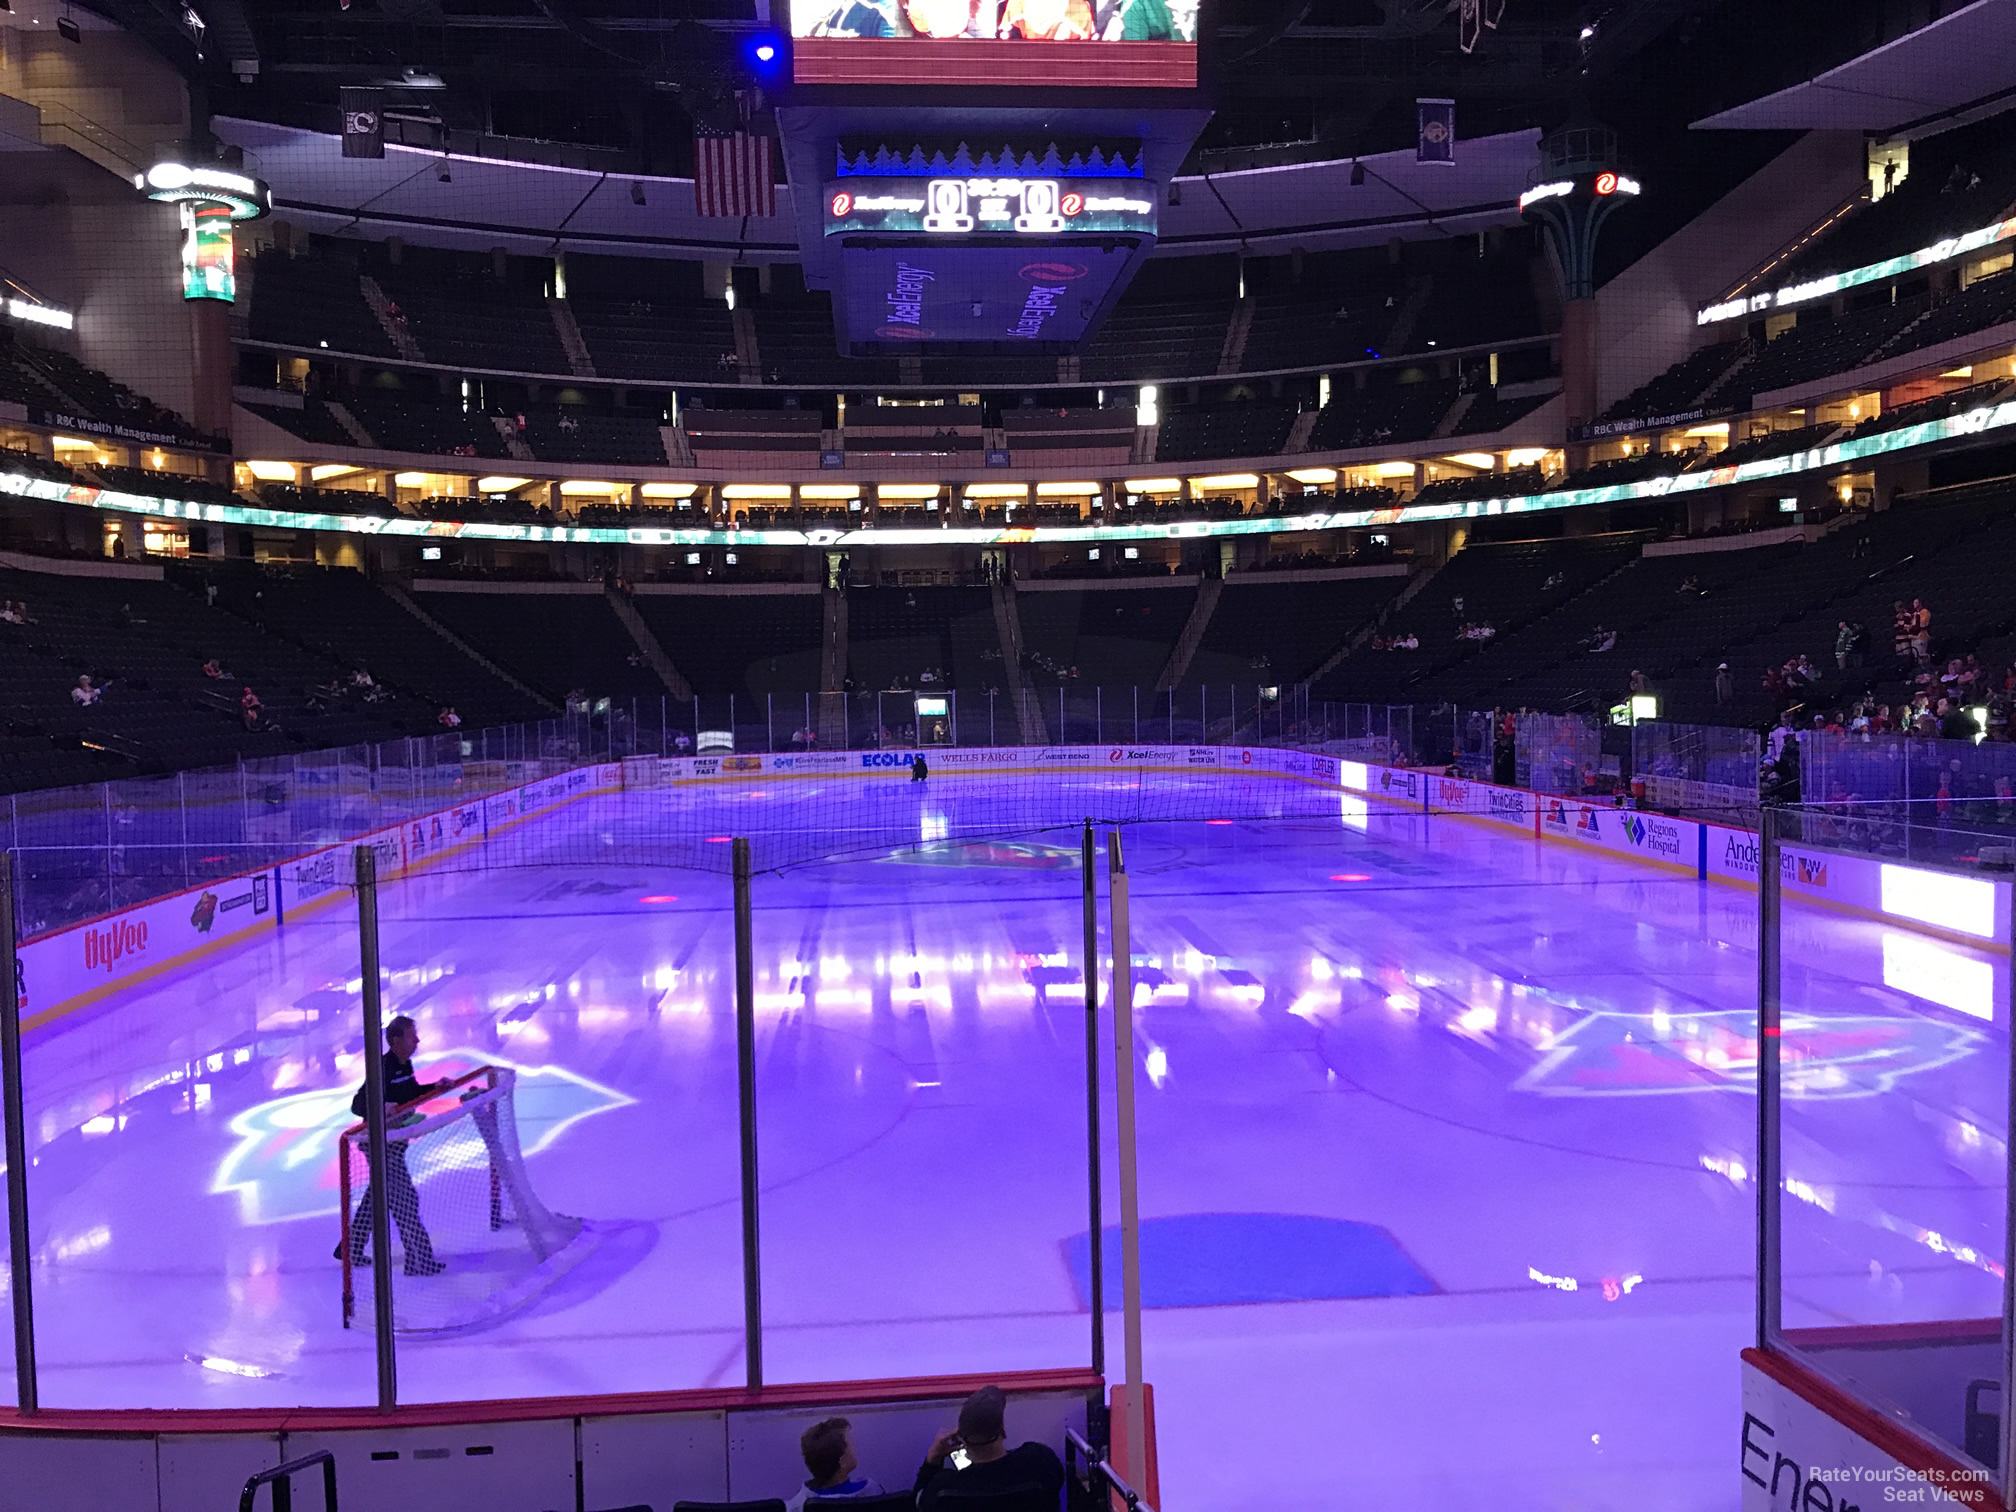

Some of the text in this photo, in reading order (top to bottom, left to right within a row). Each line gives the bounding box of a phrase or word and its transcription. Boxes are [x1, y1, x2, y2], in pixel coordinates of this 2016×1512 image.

[56, 413, 76, 428] RBC
[77, 418, 112, 434] Wealth
[114, 424, 176, 445] Management
[1594, 422, 1612, 436] RBC
[1614, 417, 1645, 433] Wealth
[1647, 408, 1703, 428] Management
[693, 758, 719, 766] FRESH
[862, 753, 925, 767] ECOLA
[941, 752, 1017, 763] WELLS FARGO
[1126, 750, 1176, 762] XcelEnergy
[1648, 819, 1678, 839] Regions
[1648, 836, 1681, 855] Hospital
[84, 918, 148, 972] HyVee
